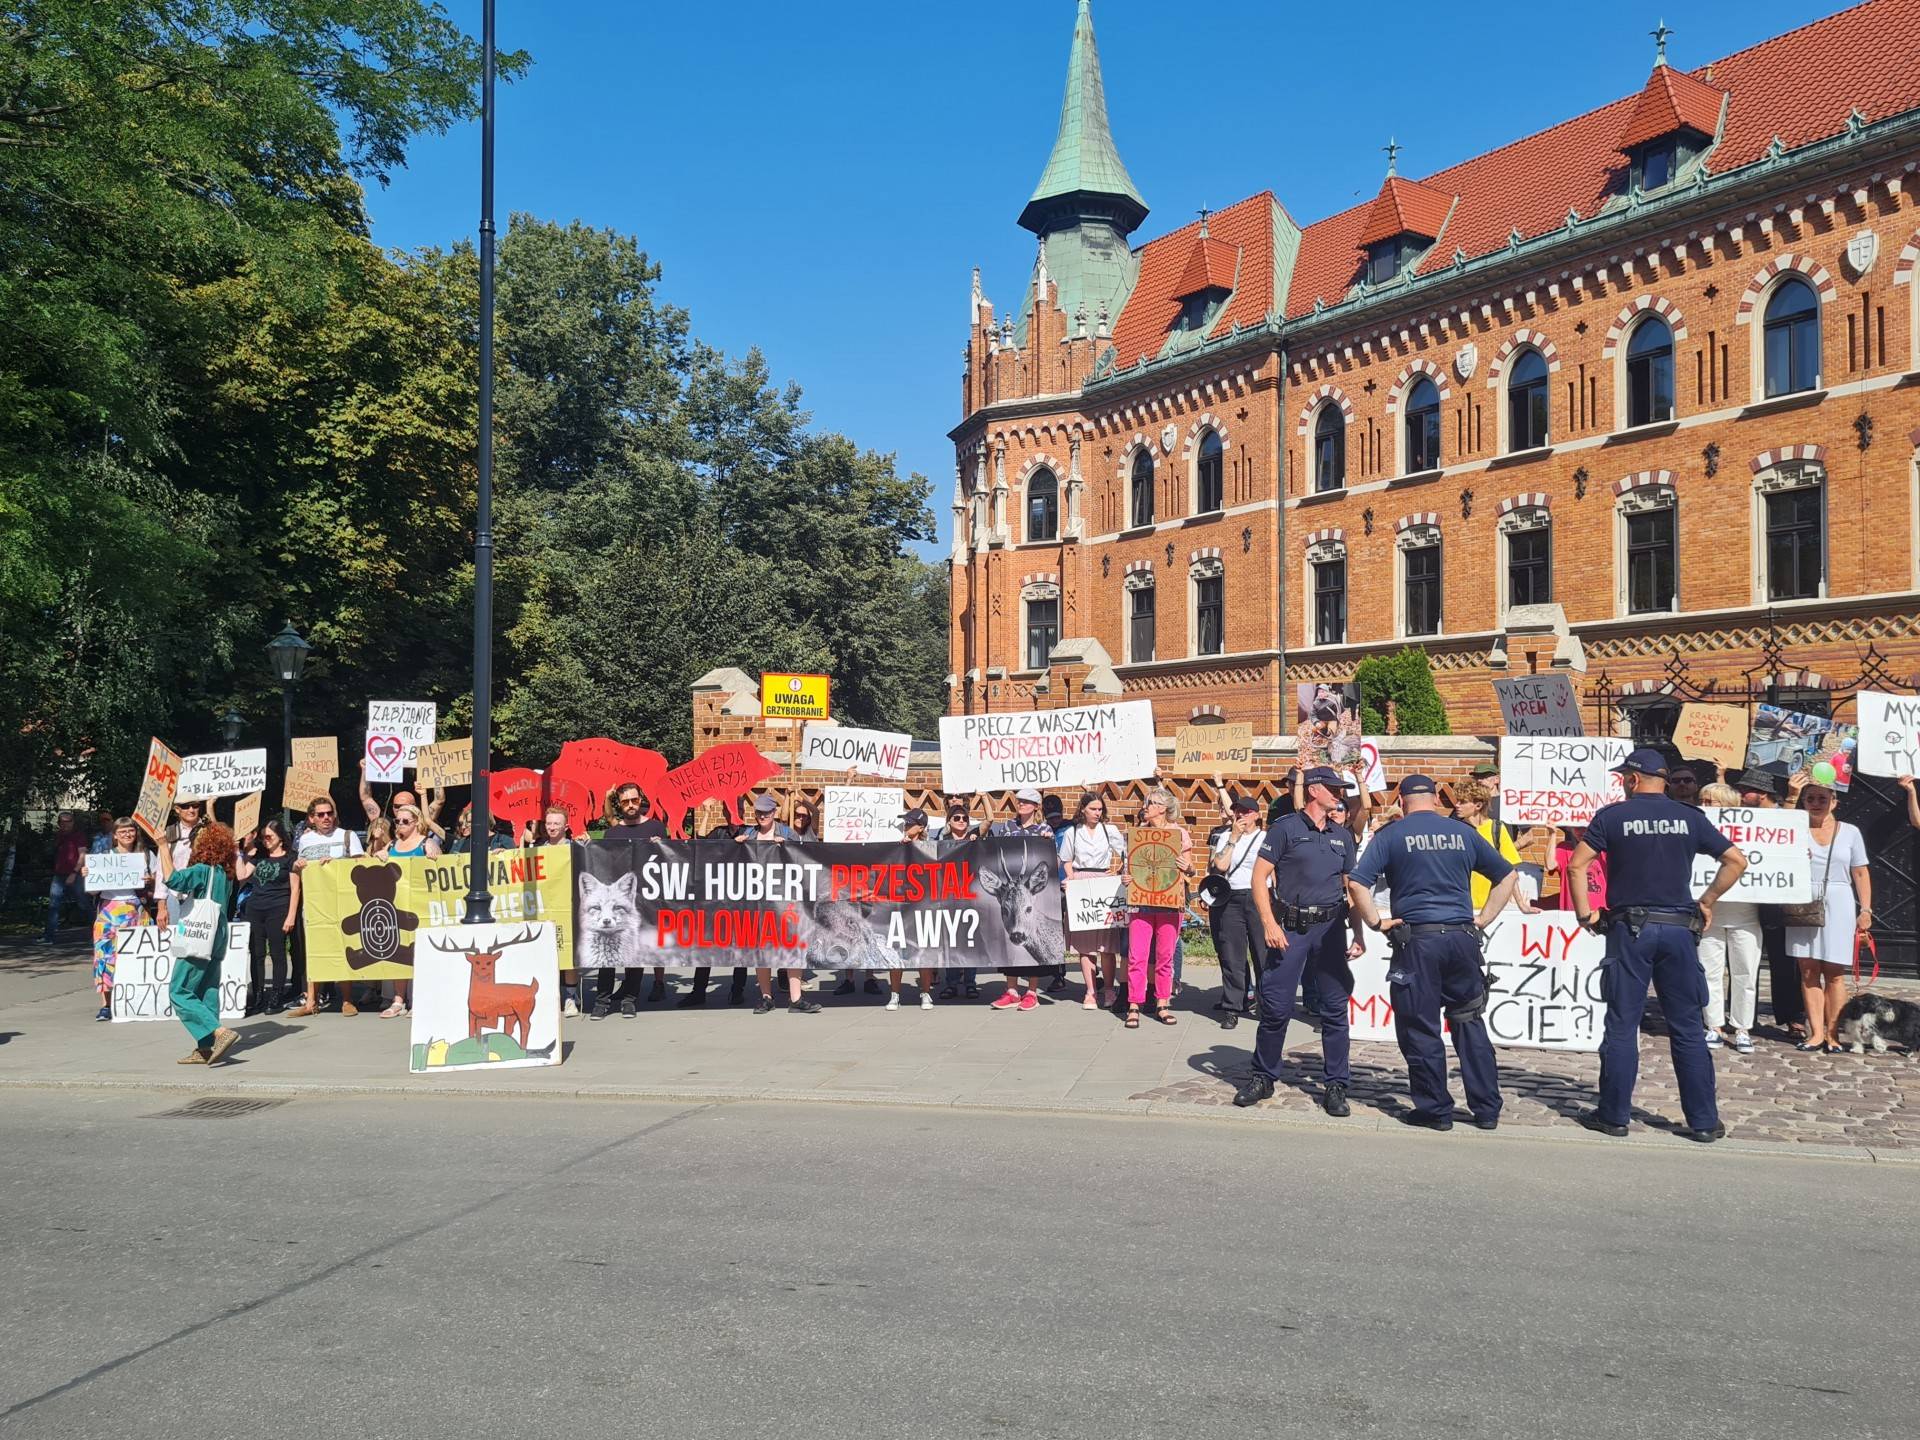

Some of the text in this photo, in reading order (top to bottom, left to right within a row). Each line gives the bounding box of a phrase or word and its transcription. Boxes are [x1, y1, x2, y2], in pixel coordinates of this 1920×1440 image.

[775, 693, 815, 705] UWAGA
[1499, 684, 1548, 700] MACIE
[372, 704, 434, 726] ZABIJANIE
[766, 705, 824, 717] GRZYBOBRANIE
[1512, 700, 1547, 717] KREW
[964, 708, 1117, 739] PRECZ Z WASZYM
[1690, 711, 1729, 725] KRAKÓW
[1509, 719, 1529, 734] NA
[1689, 721, 1725, 732] WOLNY
[420, 742, 445, 757] ALL
[978, 731, 1102, 760] POSTRZELONYM
[1514, 743, 1533, 760] Z
[305, 751, 316, 759] TO
[809, 737, 909, 770] POLOWANIE
[212, 766, 266, 781] DO DZIKA
[422, 766, 446, 778] ARE
[669, 759, 710, 789] NIECH
[1001, 759, 1061, 783] HOBBY
[1550, 767, 1587, 787] NA
[218, 778, 265, 792] ROLNIKA
[680, 777, 715, 802] NIECH
[508, 797, 529, 809] HATE
[827, 790, 903, 805] DZIK JEST
[1518, 808, 1563, 822] WSTYD
[1719, 808, 1754, 823] KTO
[1623, 819, 1689, 836] POLICJA
[845, 830, 873, 841] ZŁY
[1134, 830, 1172, 842] STOP
[1405, 834, 1466, 853] POLICJA
[103, 855, 129, 868] NIE
[88, 871, 140, 886] ZABIJAJ
[641, 854, 977, 902] ŚW. HUBERT PRZESTAŁ
[489, 889, 545, 919] ZIECI
[183, 918, 212, 931] otwarte
[1076, 909, 1104, 925] MNIE
[656, 903, 980, 949] POLOWAĆ. A WY?
[183, 928, 209, 941] klatki
[1521, 923, 1581, 960] WY
[136, 955, 170, 983] TO
